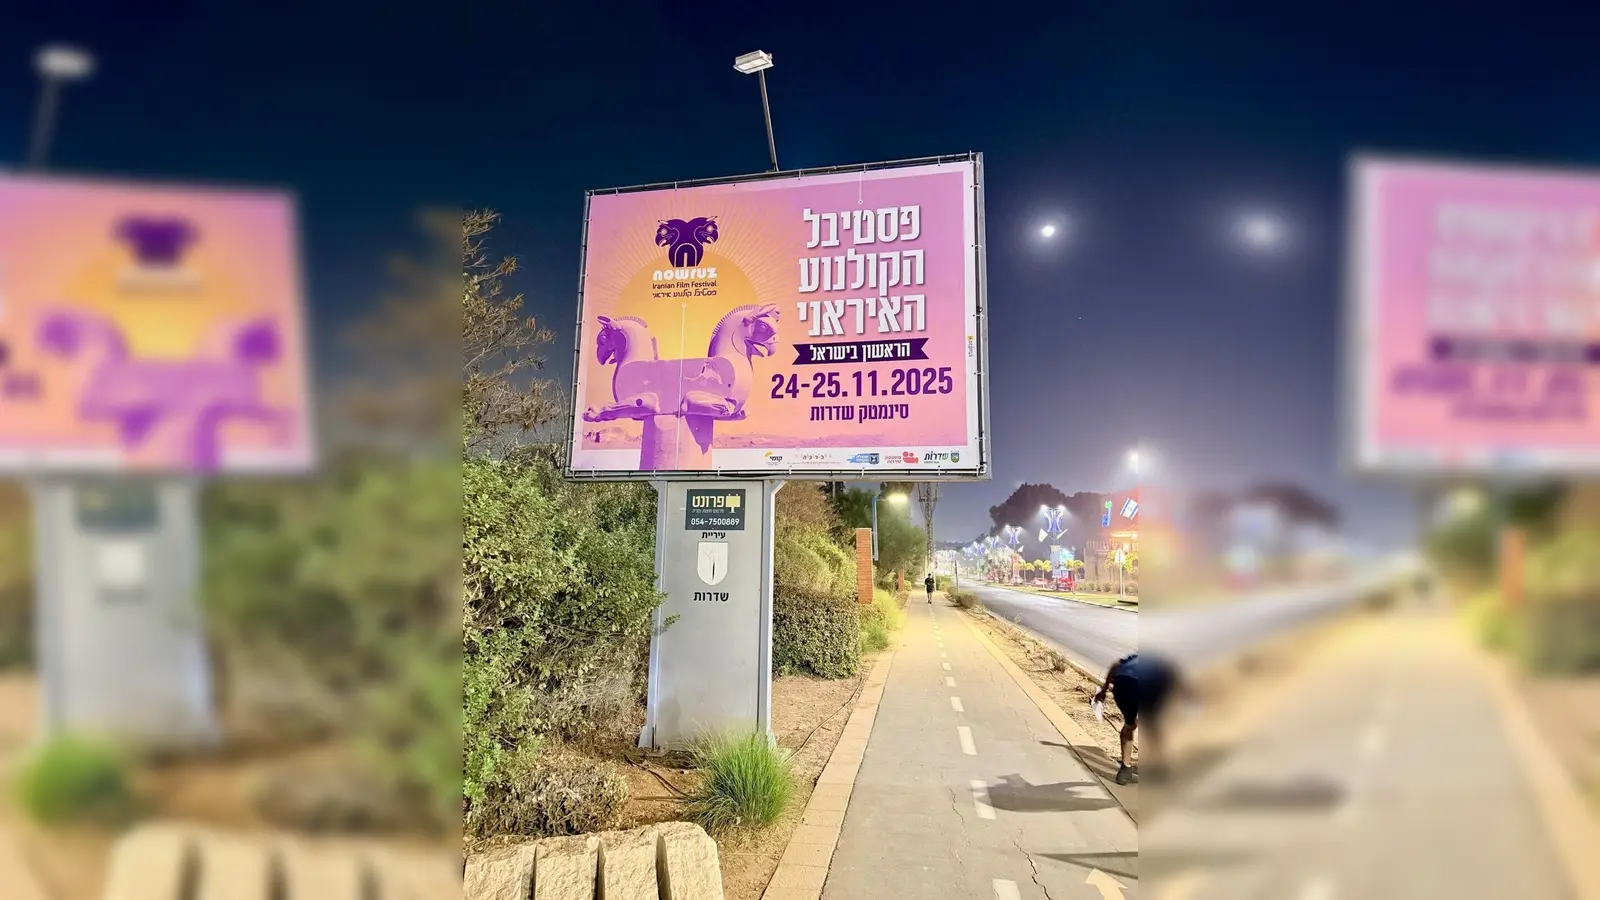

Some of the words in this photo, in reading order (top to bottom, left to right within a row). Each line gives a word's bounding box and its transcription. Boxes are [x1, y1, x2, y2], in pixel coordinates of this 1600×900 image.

[803, 205, 921, 248] פסטיבל
[653, 268, 718, 281] nowruz
[798, 248, 924, 296] הקולנוע
[691, 280, 717, 288] Festival
[672, 289, 692, 298] קולנוע
[694, 288, 717, 297] פסטיבל
[797, 294, 926, 336] האיראני
[810, 345, 858, 361] בישראל
[862, 342, 911, 362] הראשון
[771, 367, 953, 399] 24-25.11.2025
[810, 405, 855, 421] שדרות
[858, 403, 909, 423] סינמטק
[692, 495, 725, 508] פרונט
[701, 531, 726, 539] עיריית
[693, 592, 729, 602] שדרות
